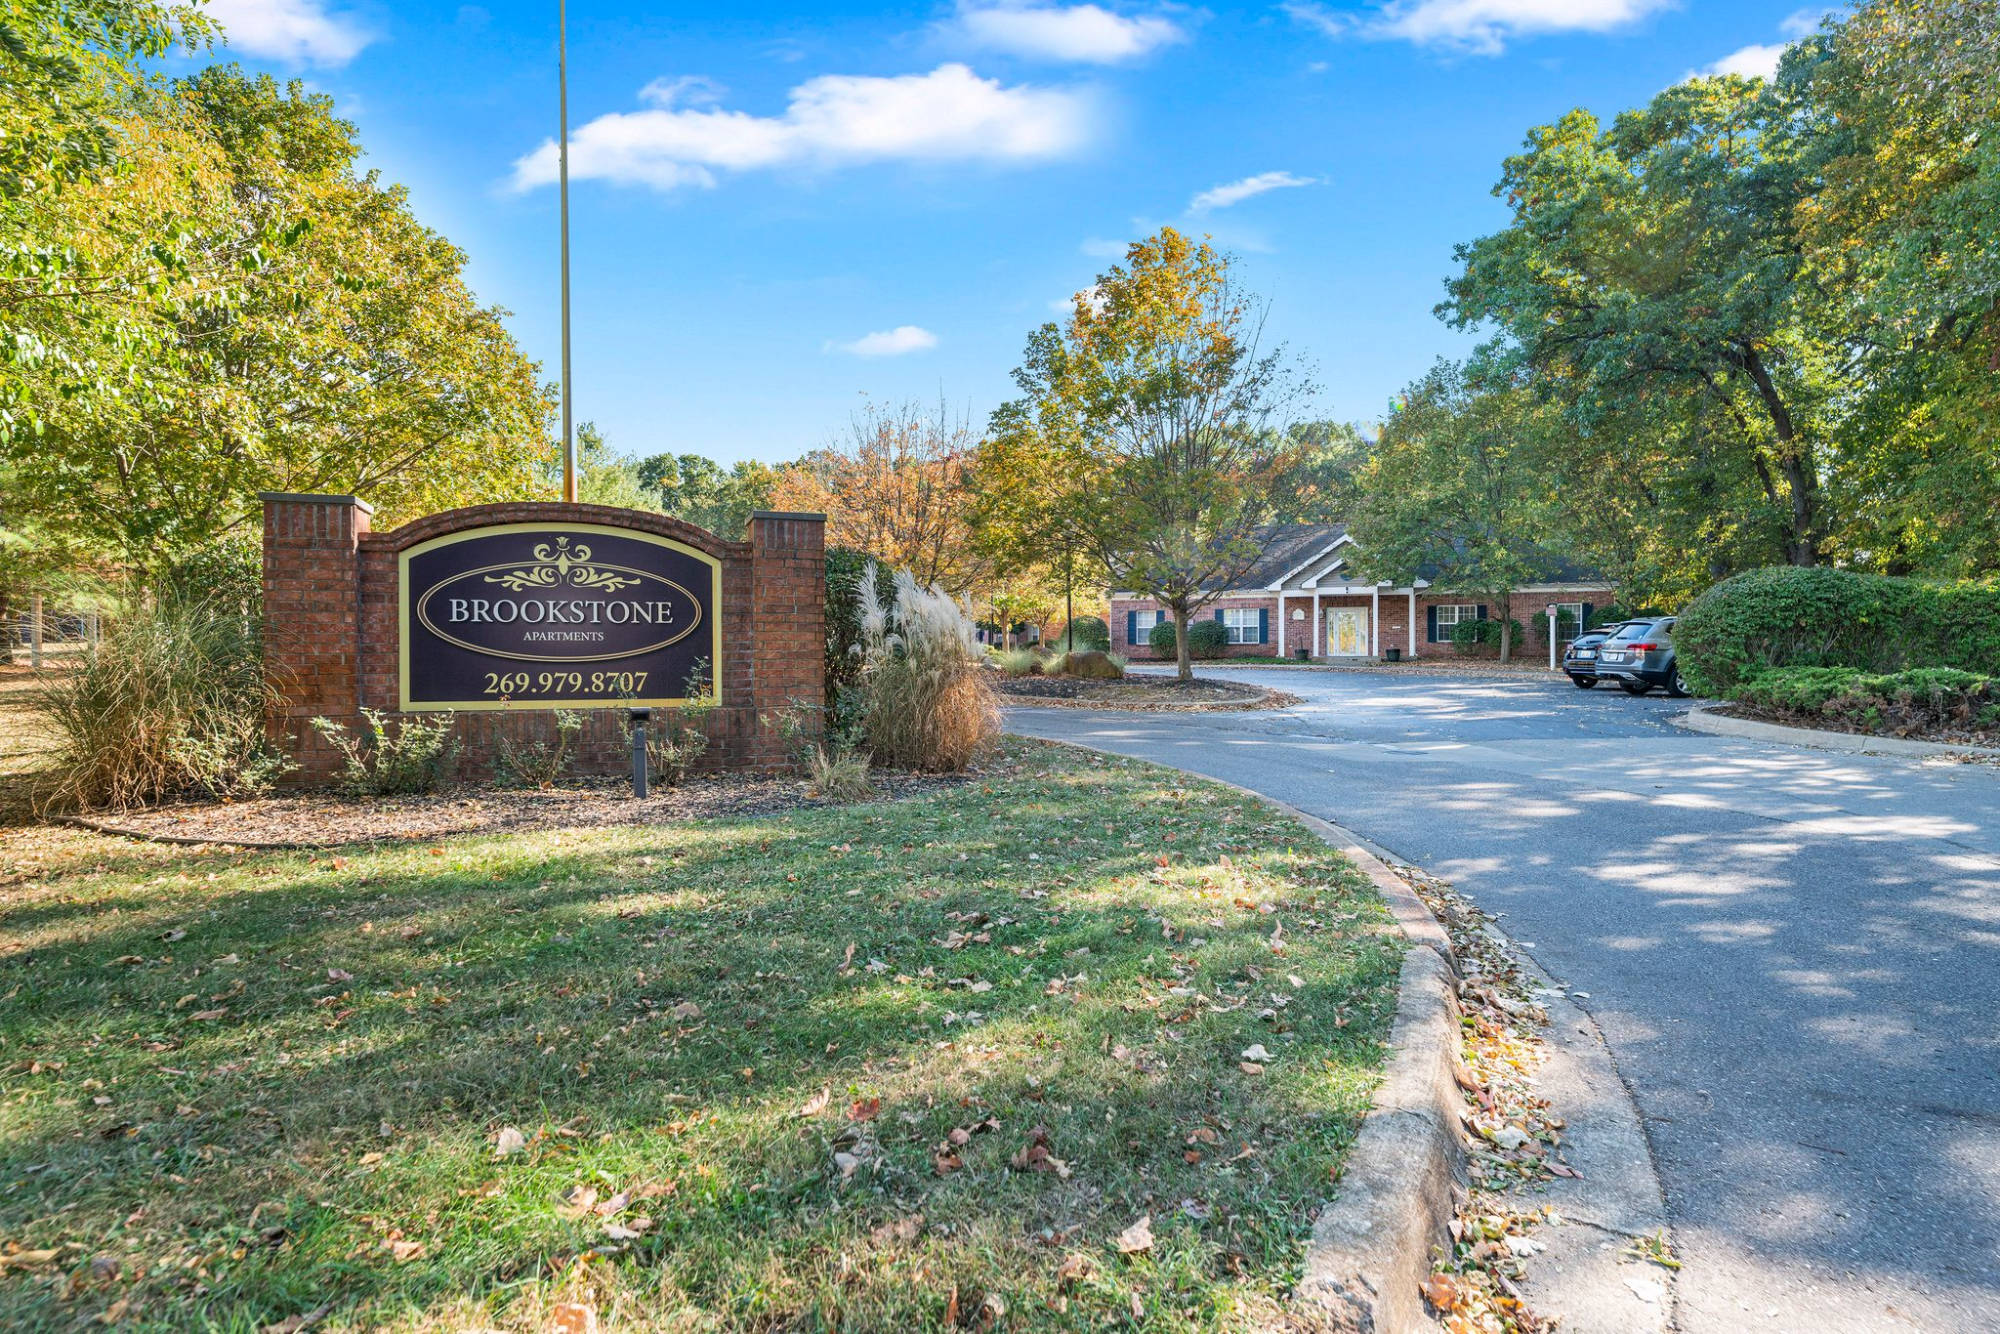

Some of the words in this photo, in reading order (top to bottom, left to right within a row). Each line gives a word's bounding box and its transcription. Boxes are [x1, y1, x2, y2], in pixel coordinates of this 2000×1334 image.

[449, 598, 673, 624] BROOKSTONE
[523, 631, 604, 641] APARTMENTS
[484, 671, 648, 693] 269.979.8707
